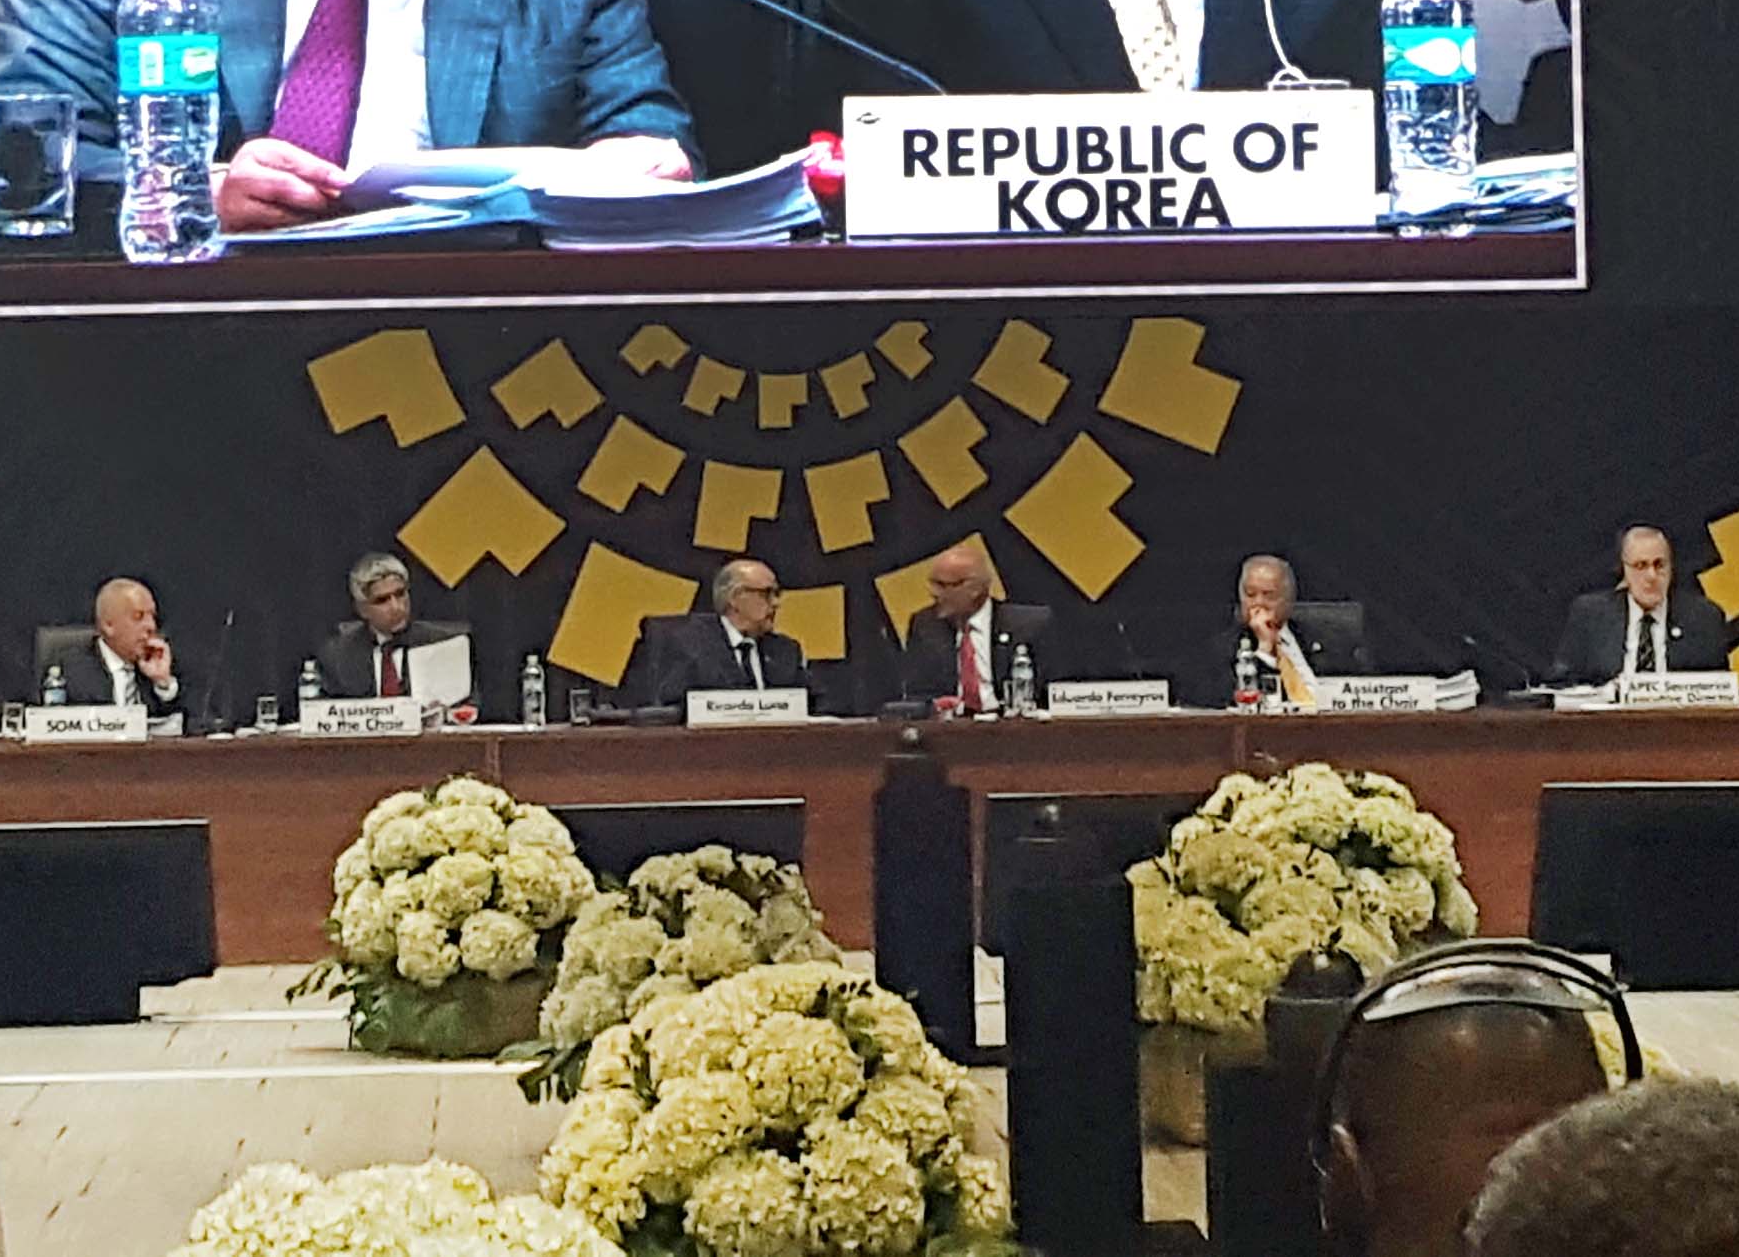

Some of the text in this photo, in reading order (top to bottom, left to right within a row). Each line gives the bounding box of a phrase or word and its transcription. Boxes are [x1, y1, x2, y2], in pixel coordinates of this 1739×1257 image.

[902, 122, 1319, 178] REPUBLIC OF
[997, 177, 1232, 231] KOREA
[47, 718, 126, 733] SOM Chair
